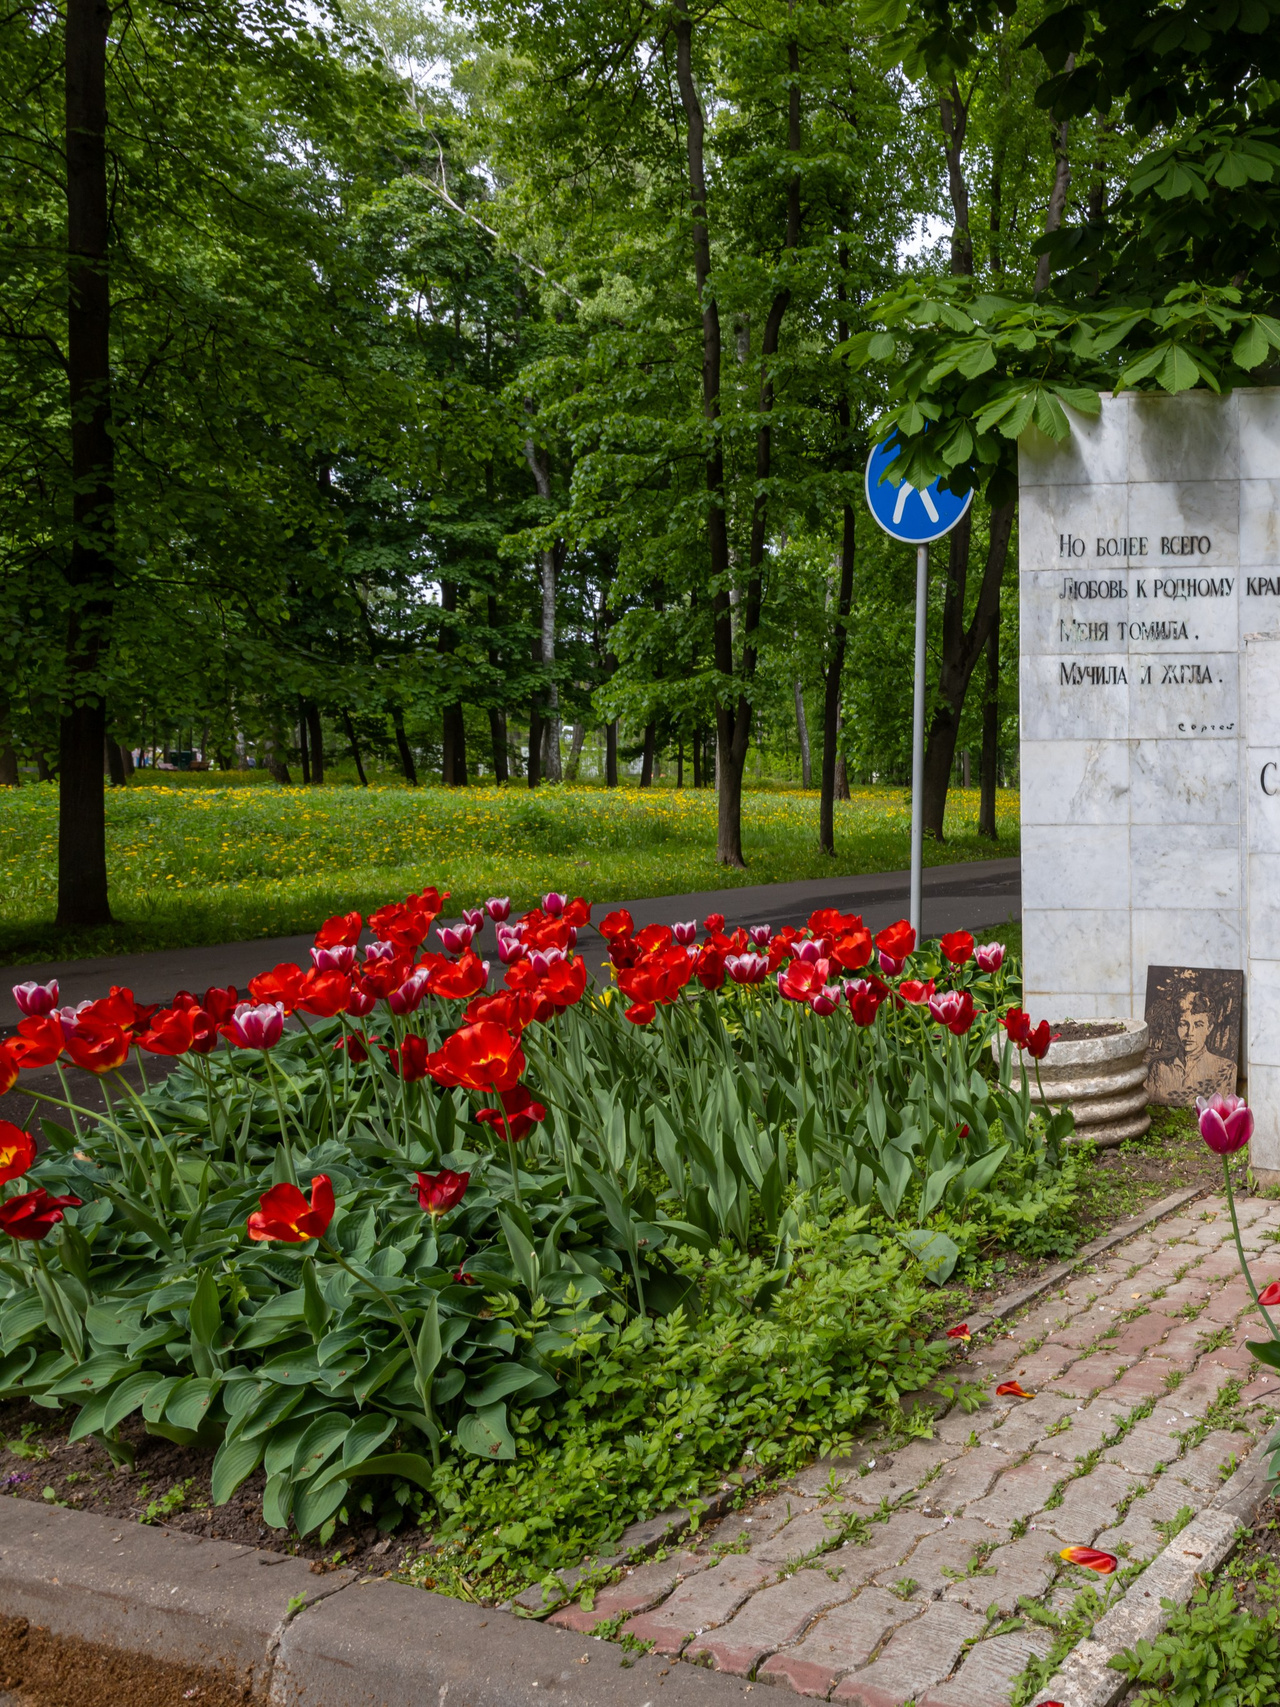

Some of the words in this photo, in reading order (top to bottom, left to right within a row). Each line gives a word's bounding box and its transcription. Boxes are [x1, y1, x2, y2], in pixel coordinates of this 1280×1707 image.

[1059, 533, 1086, 558] НО
[1096, 536, 1149, 558] БОЛЕЕ
[1160, 535, 1212, 556] ВСЕГО
[1136, 579, 1148, 599] К
[1153, 577, 1235, 602] РОДНОМУ
[1060, 661, 1129, 686] МУЧИЛА
[1140, 665, 1152, 685] И
